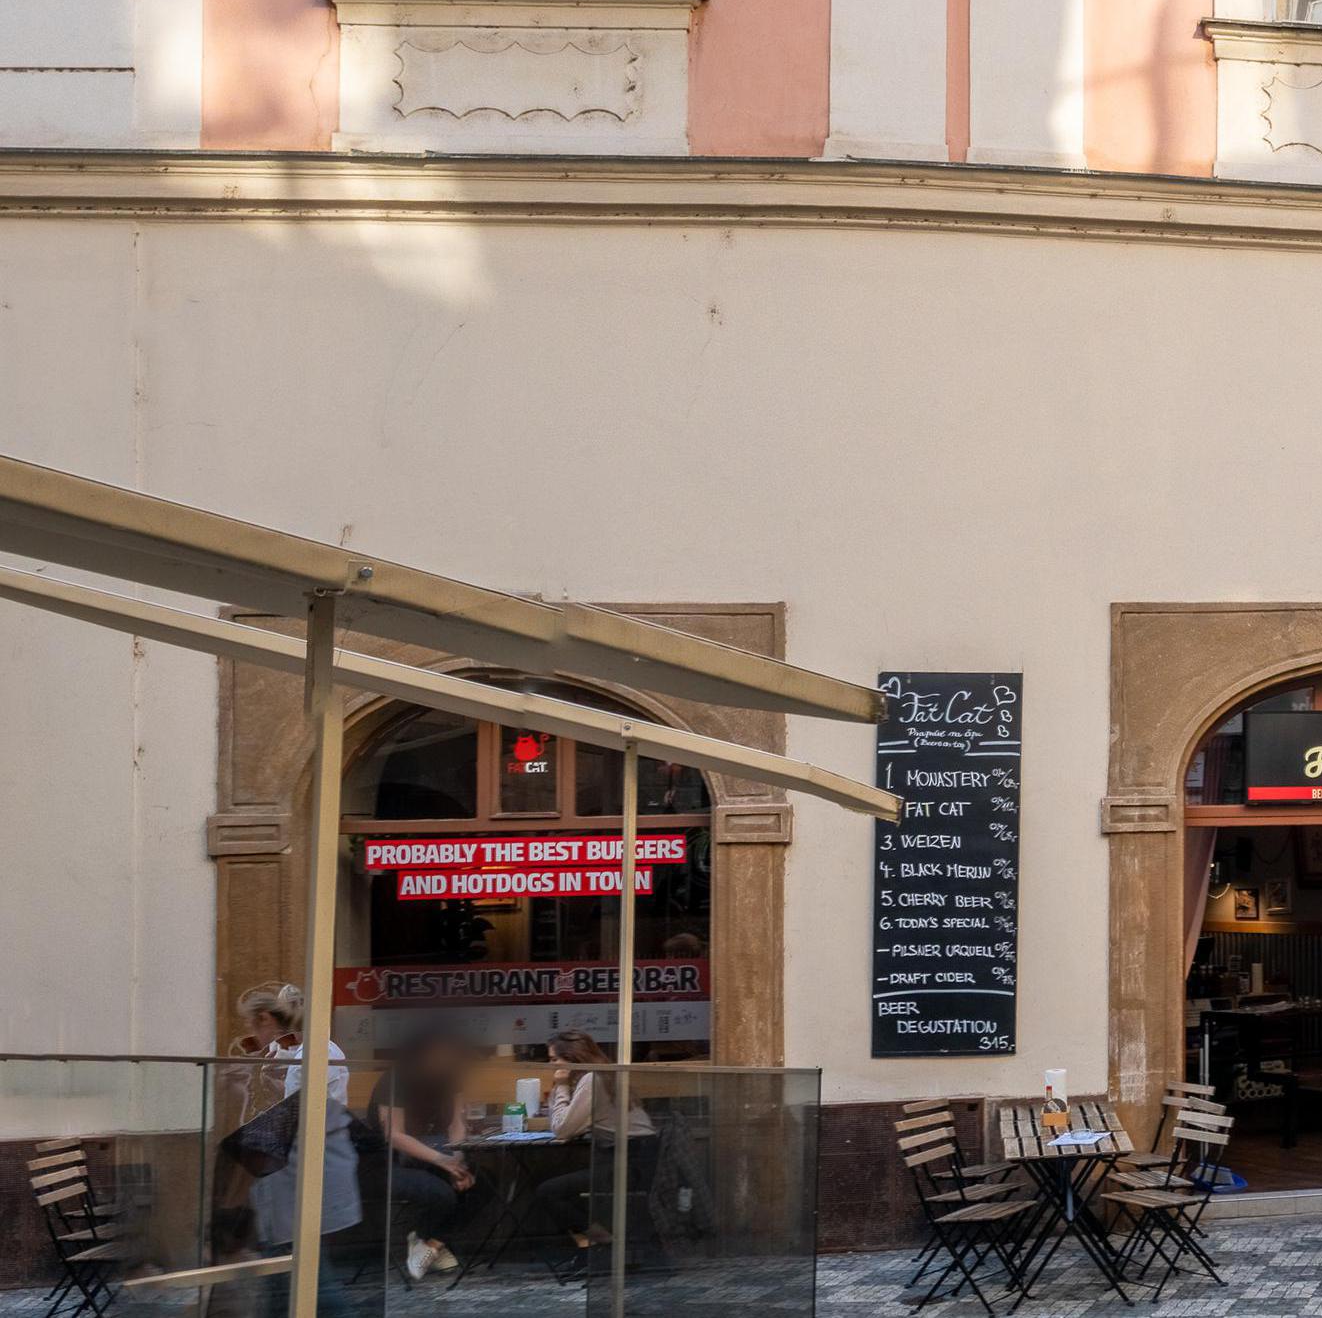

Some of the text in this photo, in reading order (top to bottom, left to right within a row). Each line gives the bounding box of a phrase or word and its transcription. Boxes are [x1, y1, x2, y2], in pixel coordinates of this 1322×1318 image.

[899, 690, 996, 725] Fat Cat
[906, 769, 991, 789] MONASTERY
[904, 801, 935, 819] FAT
[938, 801, 972, 817] CAT
[879, 834, 897, 851] 3.
[901, 834, 962, 850] WEIZEN
[367, 844, 477, 865] PROBABLY
[480, 842, 525, 863] THE
[528, 841, 583, 862] BEST
[879, 861, 896, 879] 4.
[900, 863, 943, 879] BLACK
[400, 875, 447, 895] AND
[451, 872, 554, 894] HOTDOGS
[559, 871, 581, 891] IN
[880, 890, 897, 908] 5.
[897, 892, 949, 908] CHERRY
[954, 895, 994, 909] BEER
[879, 916, 894, 931] 6.
[894, 916, 939, 930] TODAY'S
[941, 917, 990, 930] SPECIAL
[891, 944, 942, 958] PILSNER
[945, 945, 996, 958] URQUELL
[386, 969, 561, 1000] RESTAURANT
[644, 966, 699, 992] BAR
[889, 972, 932, 984] DRAFT
[934, 972, 977, 984] CIDER
[877, 1001, 921, 1017] BEER
[896, 1019, 998, 1035] DEGUSTATION
